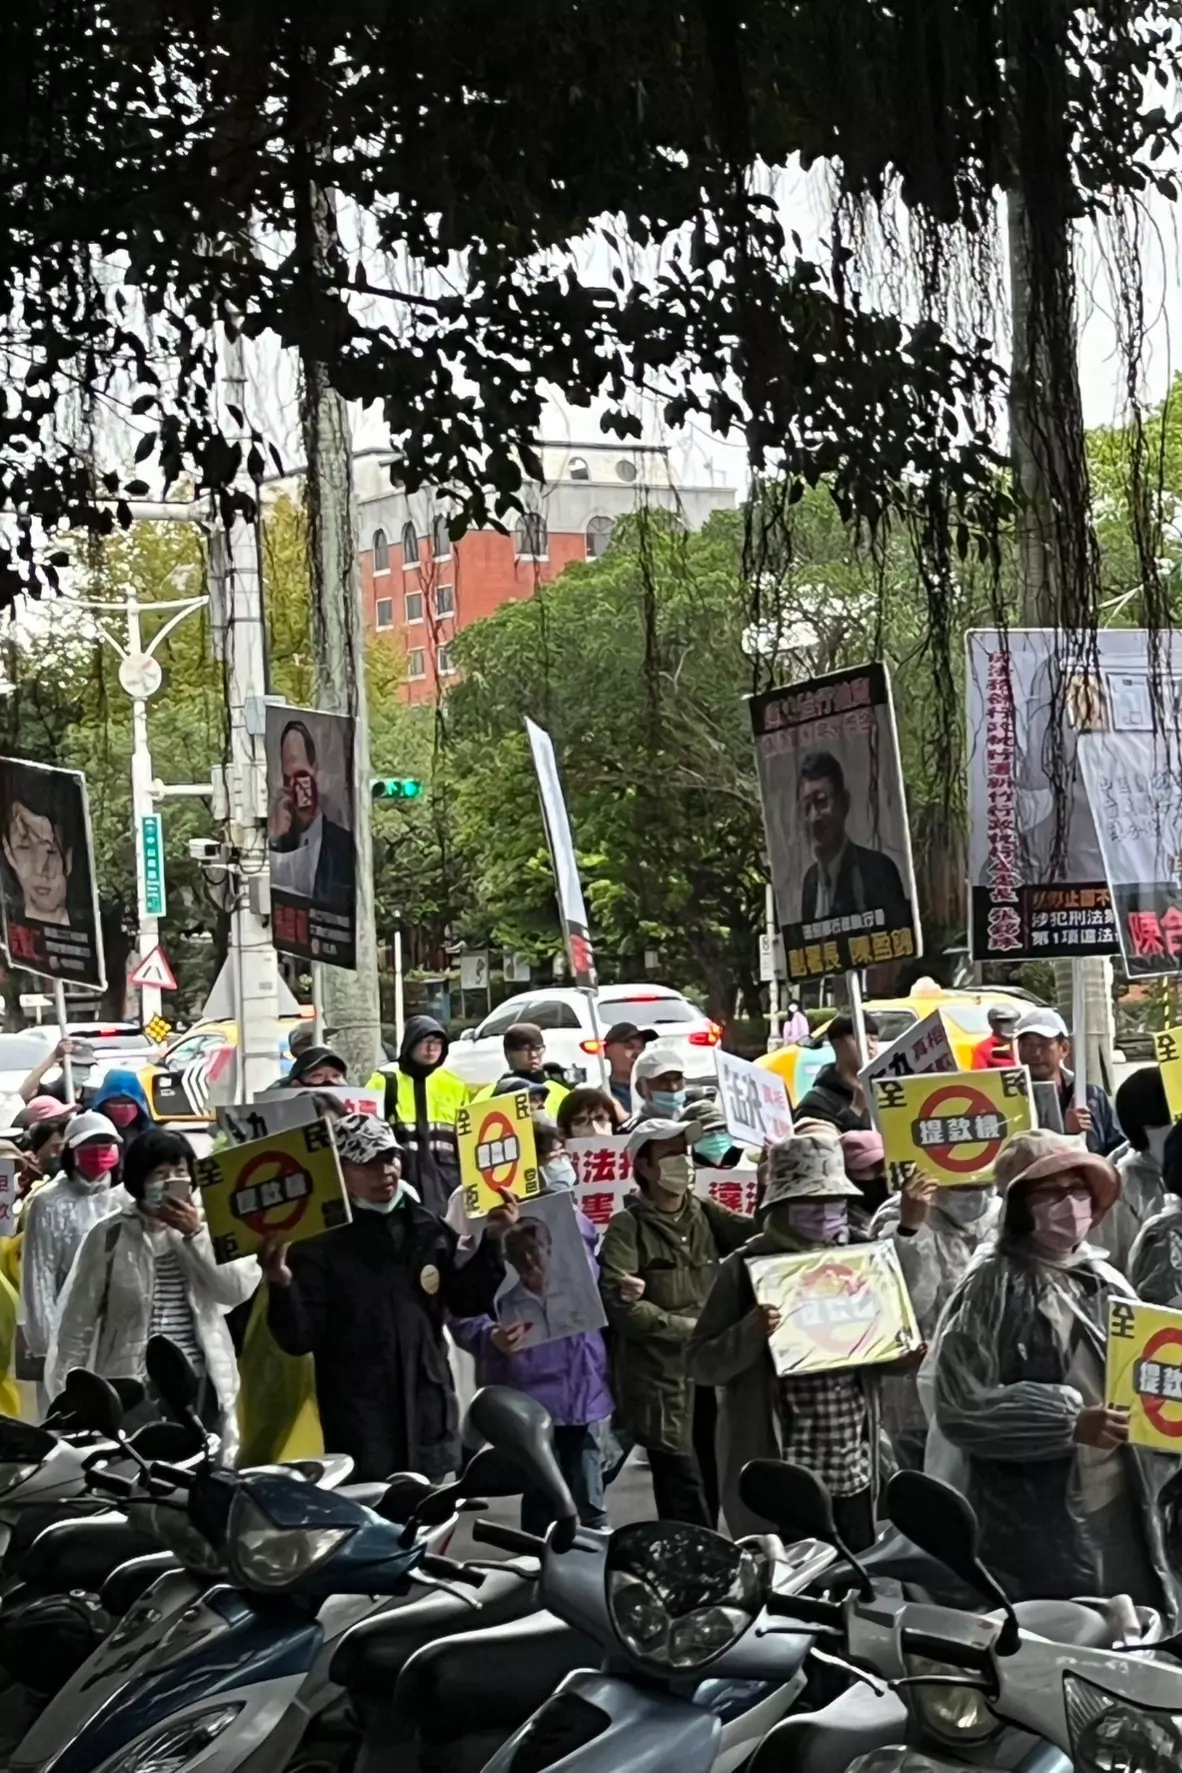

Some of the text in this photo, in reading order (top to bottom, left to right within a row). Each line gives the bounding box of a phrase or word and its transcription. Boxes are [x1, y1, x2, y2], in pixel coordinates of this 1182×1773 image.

[1032, 928, 1119, 947] 第1項違法
[1157, 1034, 1180, 1063] 全
[877, 1068, 1028, 1109] 全 民
[457, 1093, 530, 1136] 全 民
[918, 1115, 1000, 1145] 提款機
[195, 1159, 224, 1188] 全
[303, 1121, 333, 1152] 民
[1111, 1301, 1135, 1339] 全
